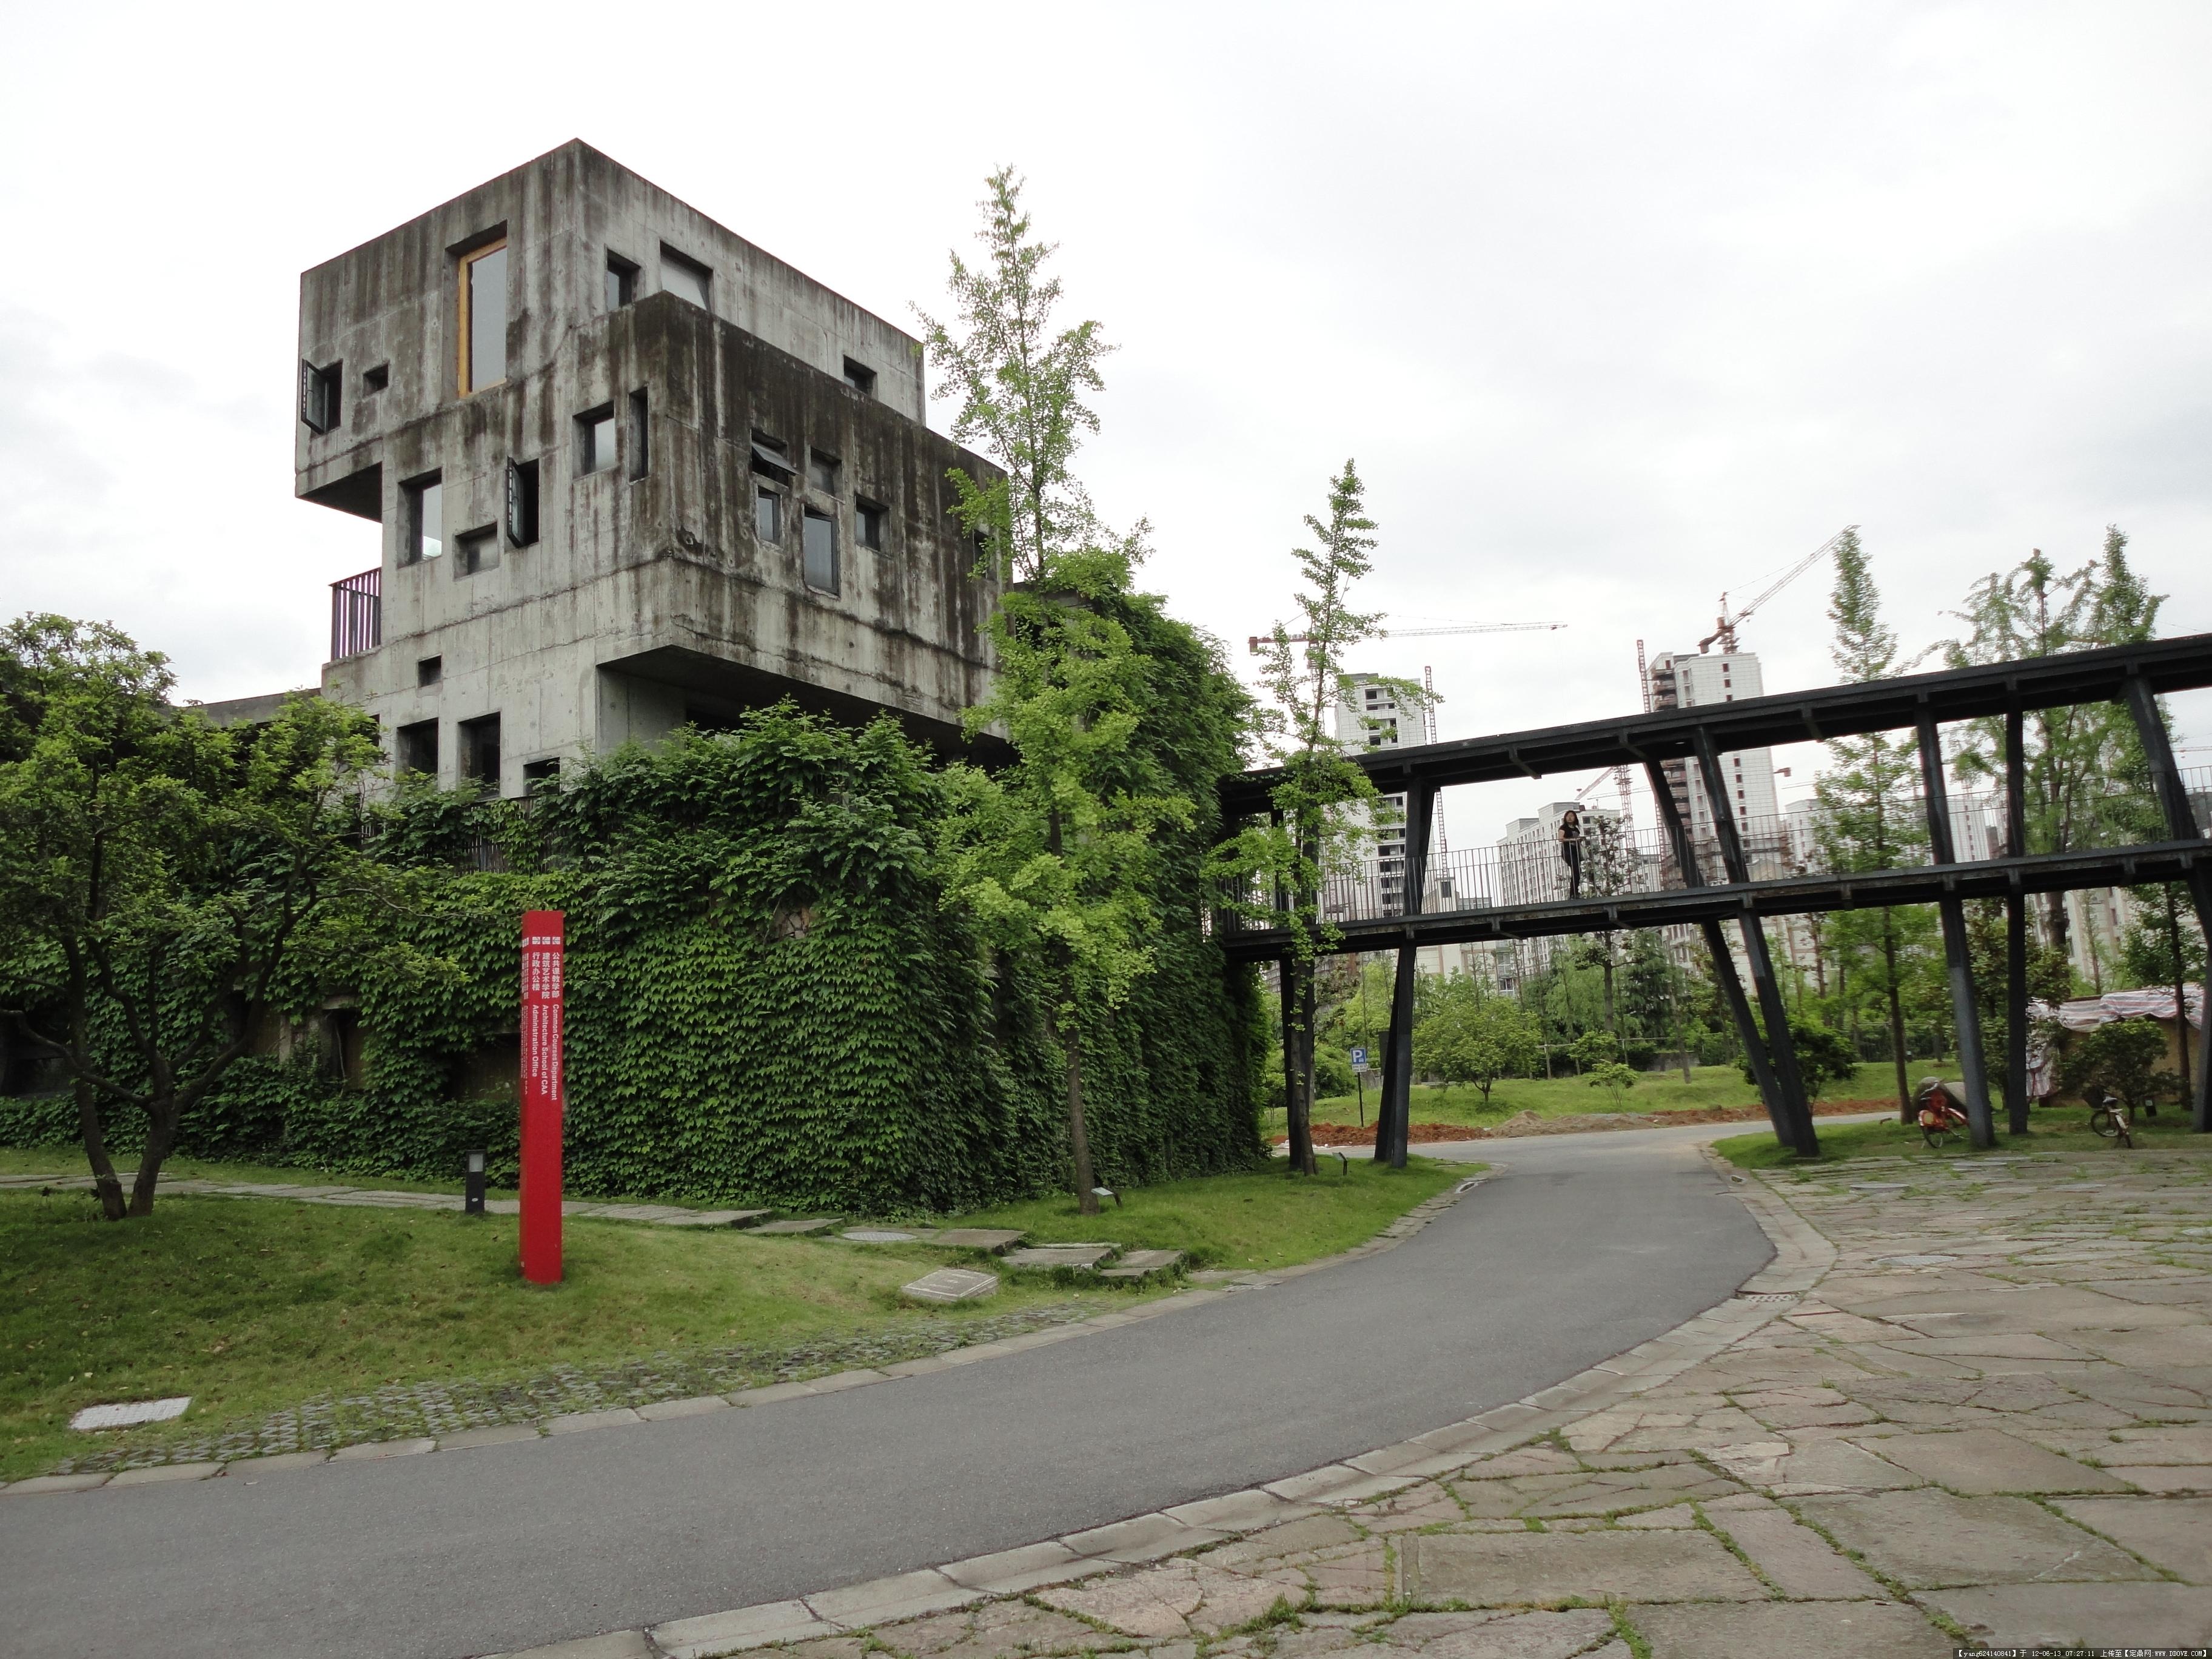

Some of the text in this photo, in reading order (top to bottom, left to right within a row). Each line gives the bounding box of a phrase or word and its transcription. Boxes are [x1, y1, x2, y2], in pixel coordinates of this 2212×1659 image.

[541, 953, 550, 999] 建筑艺术学院
[1352, 1050, 1362, 1062] P
